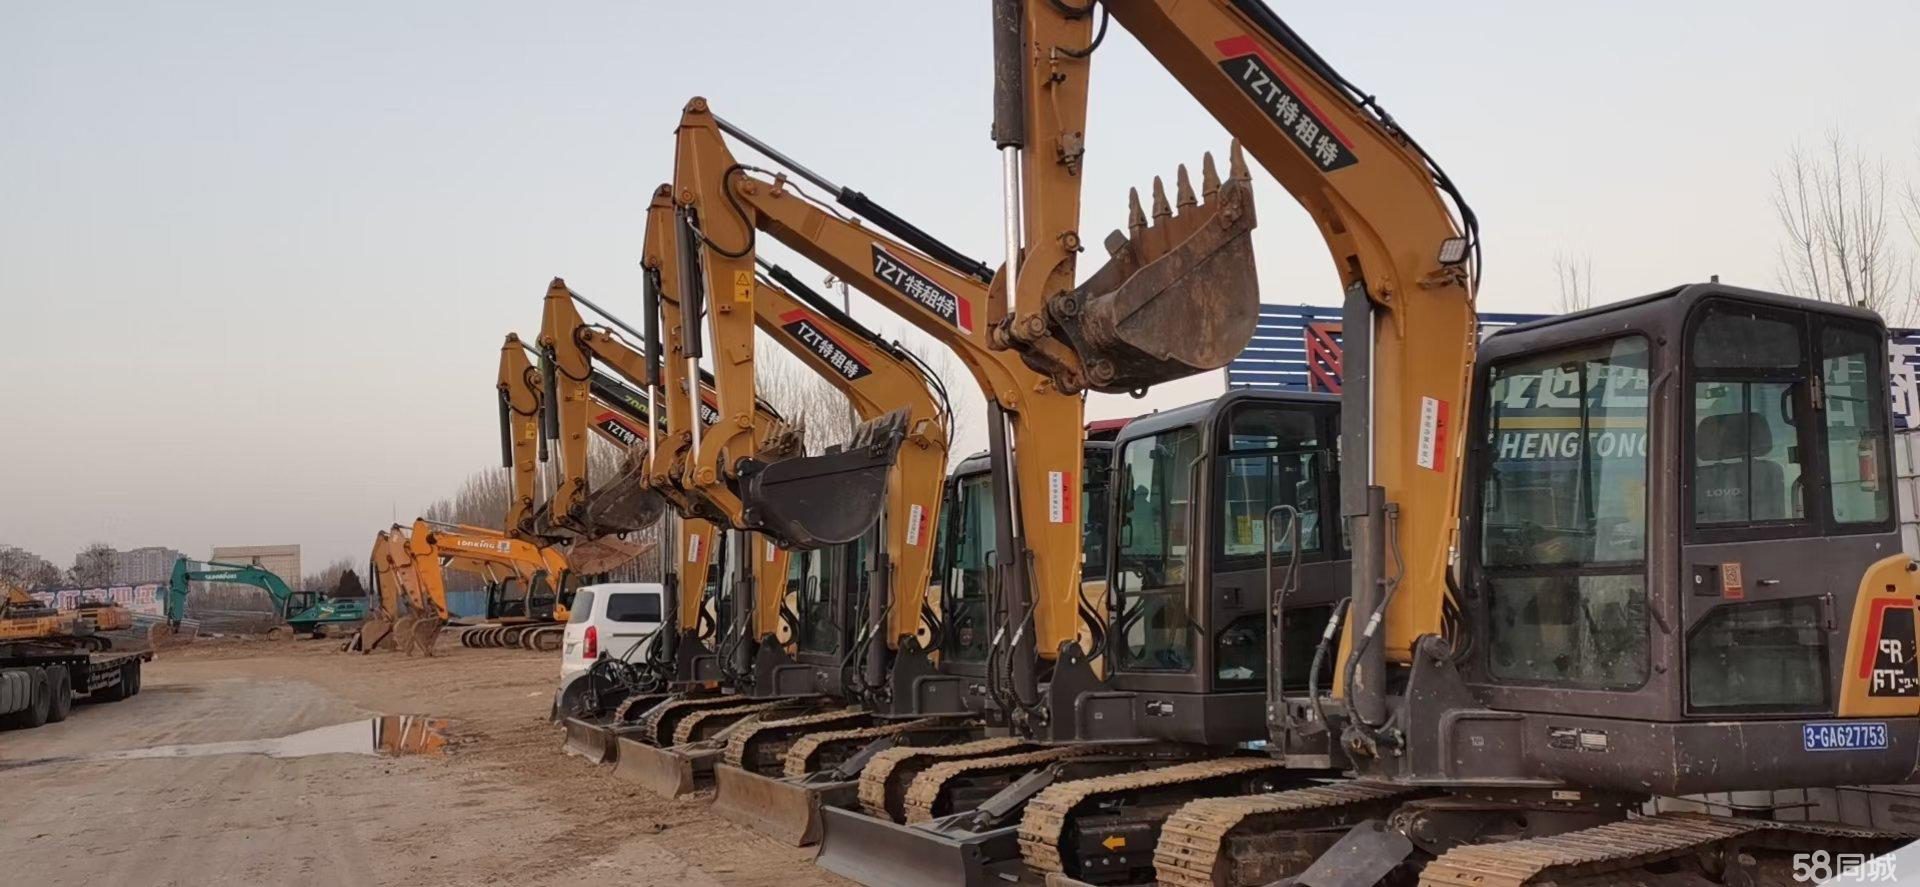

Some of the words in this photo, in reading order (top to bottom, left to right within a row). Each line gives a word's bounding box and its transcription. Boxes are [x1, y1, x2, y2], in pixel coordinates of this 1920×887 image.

[1243, 58, 1340, 167] TZT特租特
[875, 254, 956, 318] TZT特租特
[797, 321, 859, 378] TZT特租特
[1806, 726, 1886, 748] 3-GA627753
